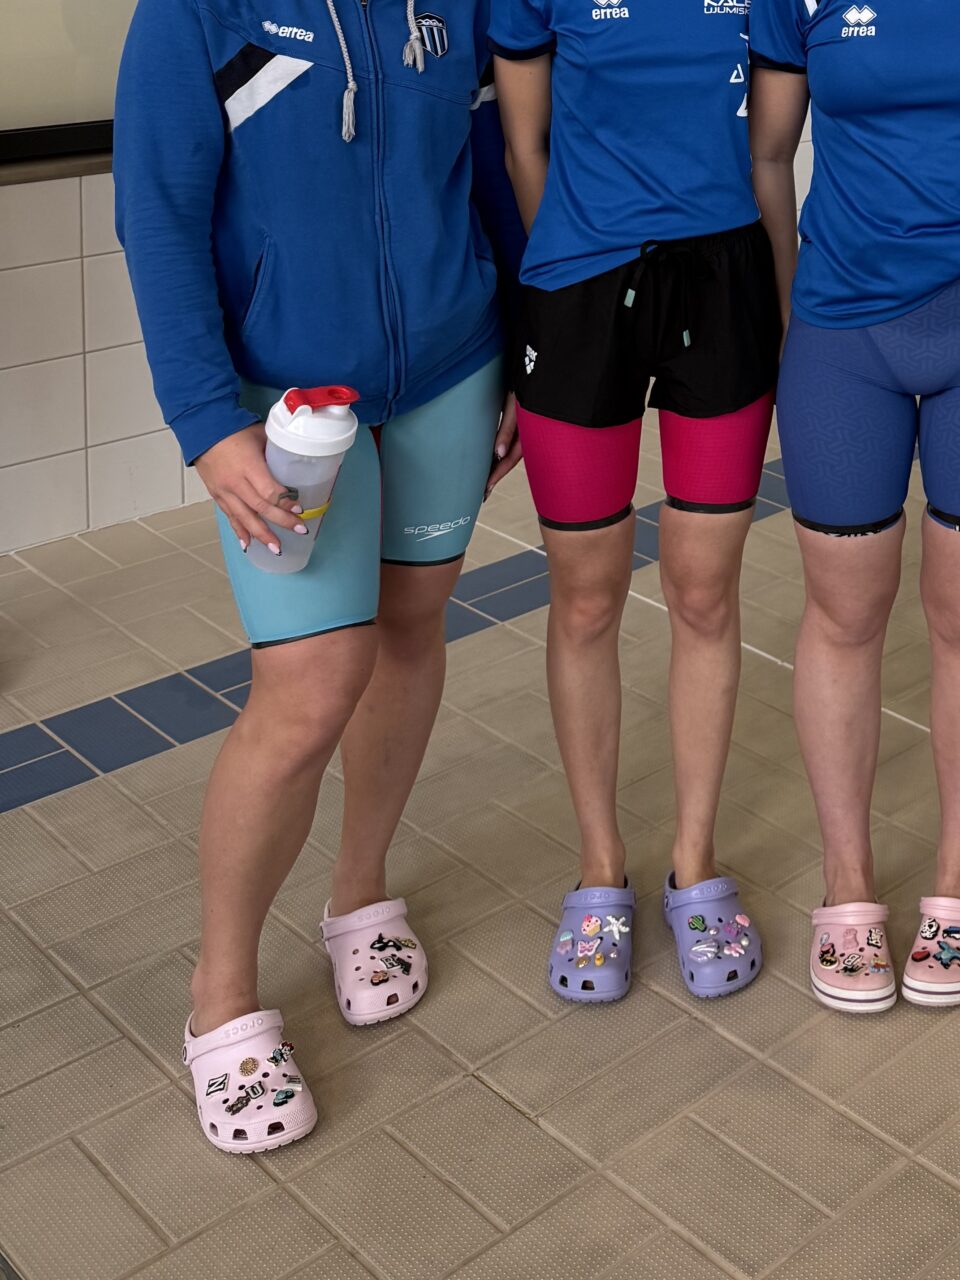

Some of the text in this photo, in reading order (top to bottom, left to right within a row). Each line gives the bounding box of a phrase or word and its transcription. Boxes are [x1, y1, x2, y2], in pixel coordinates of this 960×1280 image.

[592, 6, 630, 20] errea
[278, 25, 315, 42] errea
[841, 25, 876, 38] errea
[404, 516, 471, 535] speedo
[223, 1016, 264, 1040] crocs
